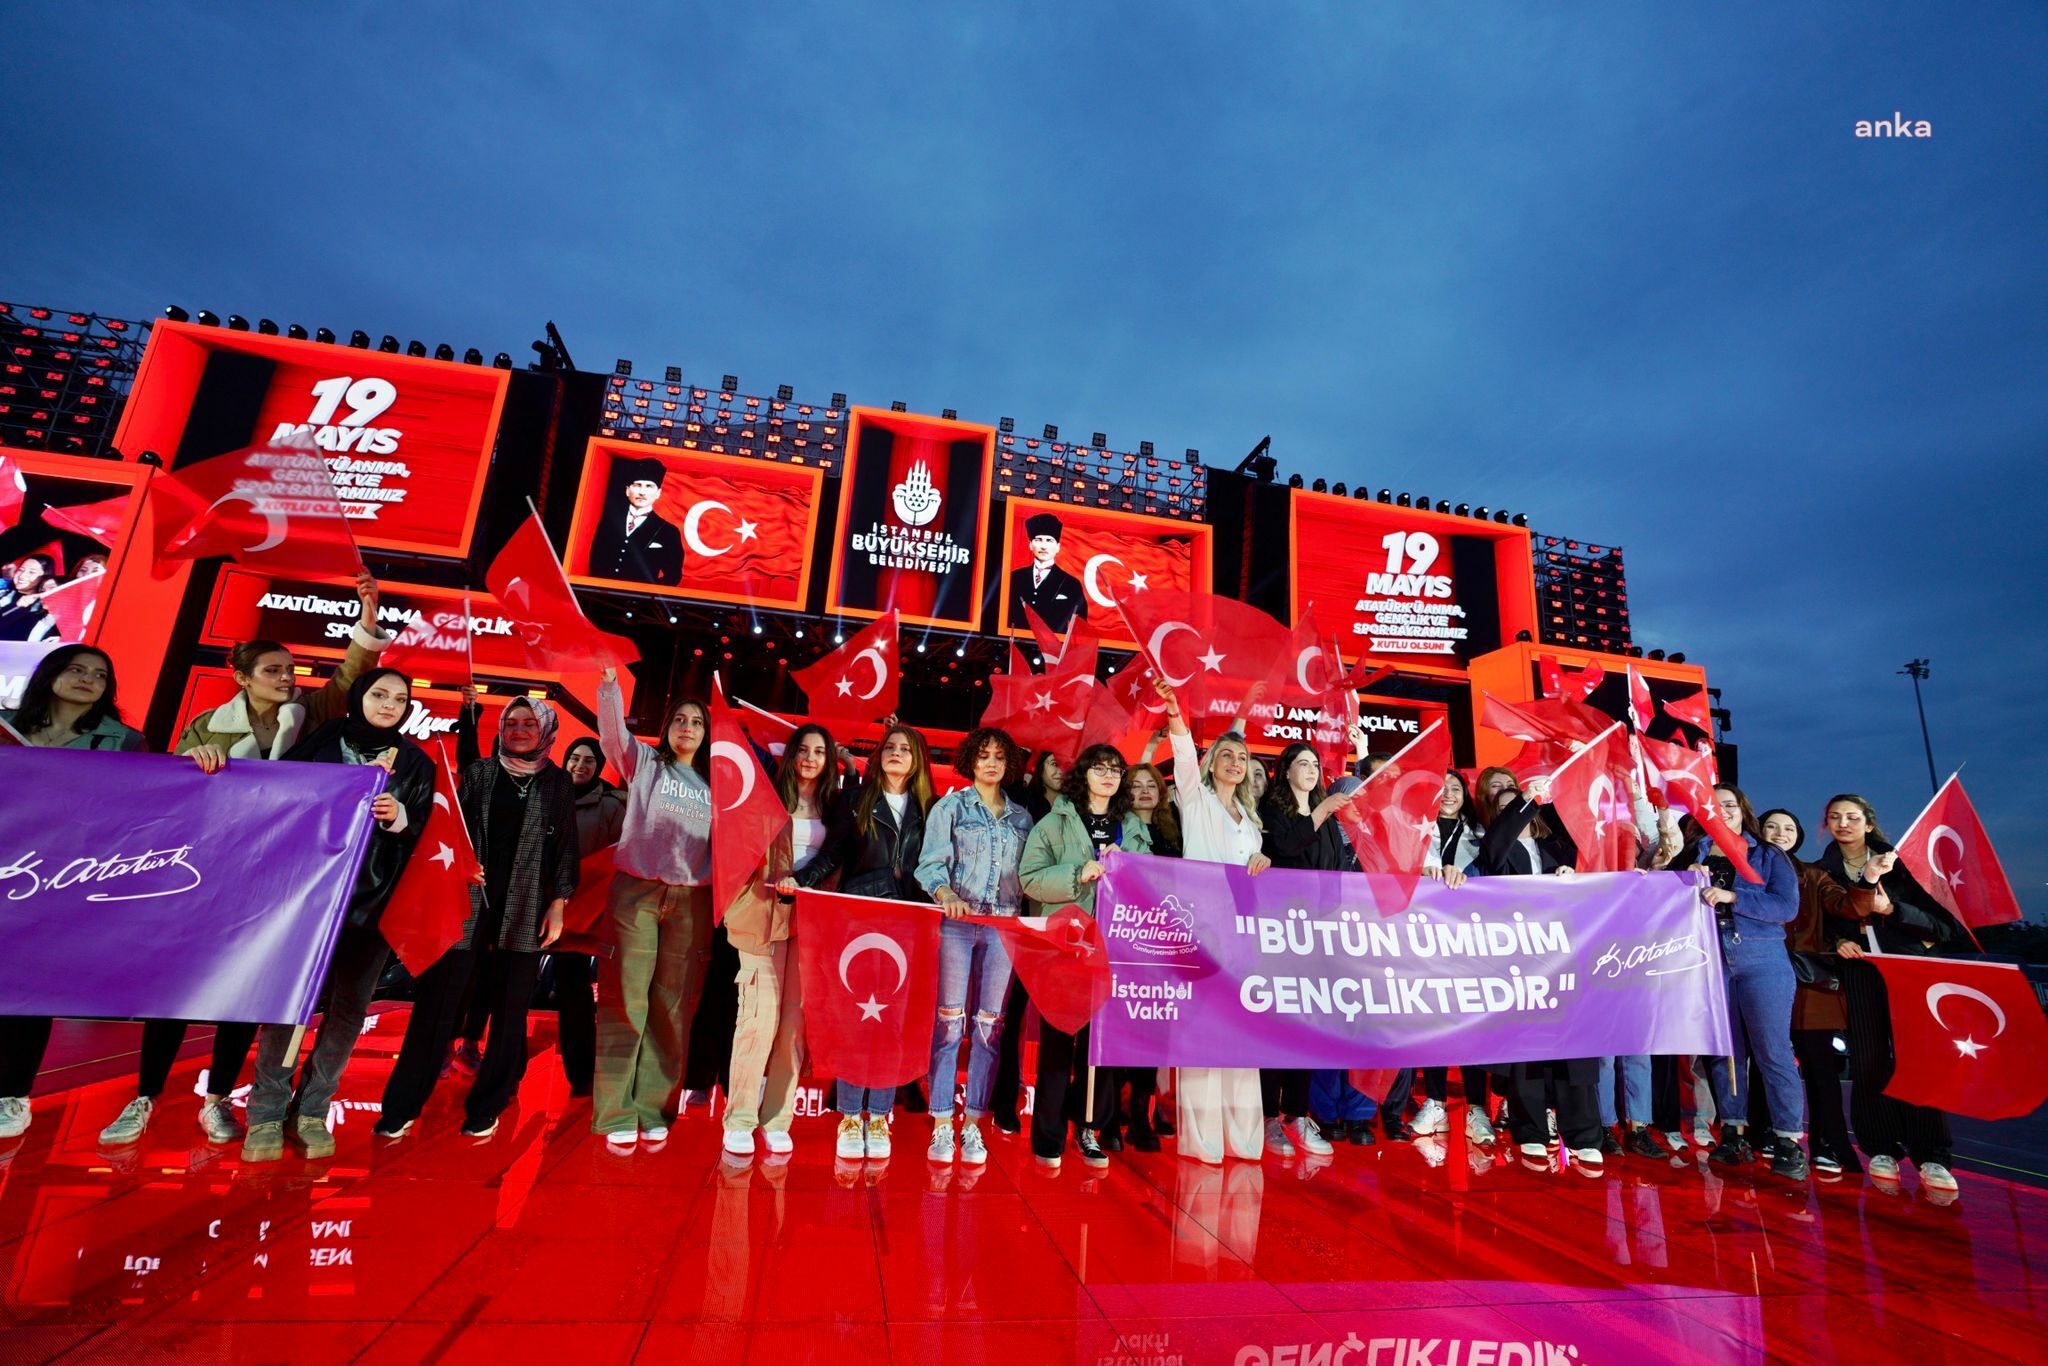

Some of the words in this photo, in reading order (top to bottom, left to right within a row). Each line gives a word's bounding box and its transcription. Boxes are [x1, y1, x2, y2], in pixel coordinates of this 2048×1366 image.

[307, 376, 398, 427] 19
[268, 422, 403, 454] MAYIS
[872, 522, 954, 545] İSTANBUL
[852, 533, 970, 564] BÜYÜKŞEHİR
[1382, 531, 1440, 575] 19
[869, 554, 951, 574] BELEDİYESİ
[1366, 572, 1453, 599] MAYIS
[257, 592, 361, 617] ATATÜRK'Ü
[1353, 623, 1390, 635] SPOR
[1430, 615, 1449, 627] VE
[1377, 640, 1408, 649] KUTLU
[1409, 642, 1445, 651] OLSUN!
[1263, 724, 1303, 740] SPOR
[1399, 719, 1419, 733] VE
[661, 775, 712, 806] BROOKL
[660, 801, 684, 815] URBAN
[1112, 903, 1168, 927] Büyüt
[1108, 923, 1193, 943] Hayallerini
[1235, 908, 1401, 957] "BÜTÜN
[1406, 911, 1572, 958] ÜMİDİM
[1239, 965, 1576, 1022] GENÇLİKTEDİR."
[1126, 1001, 1178, 1021] Vakfı
